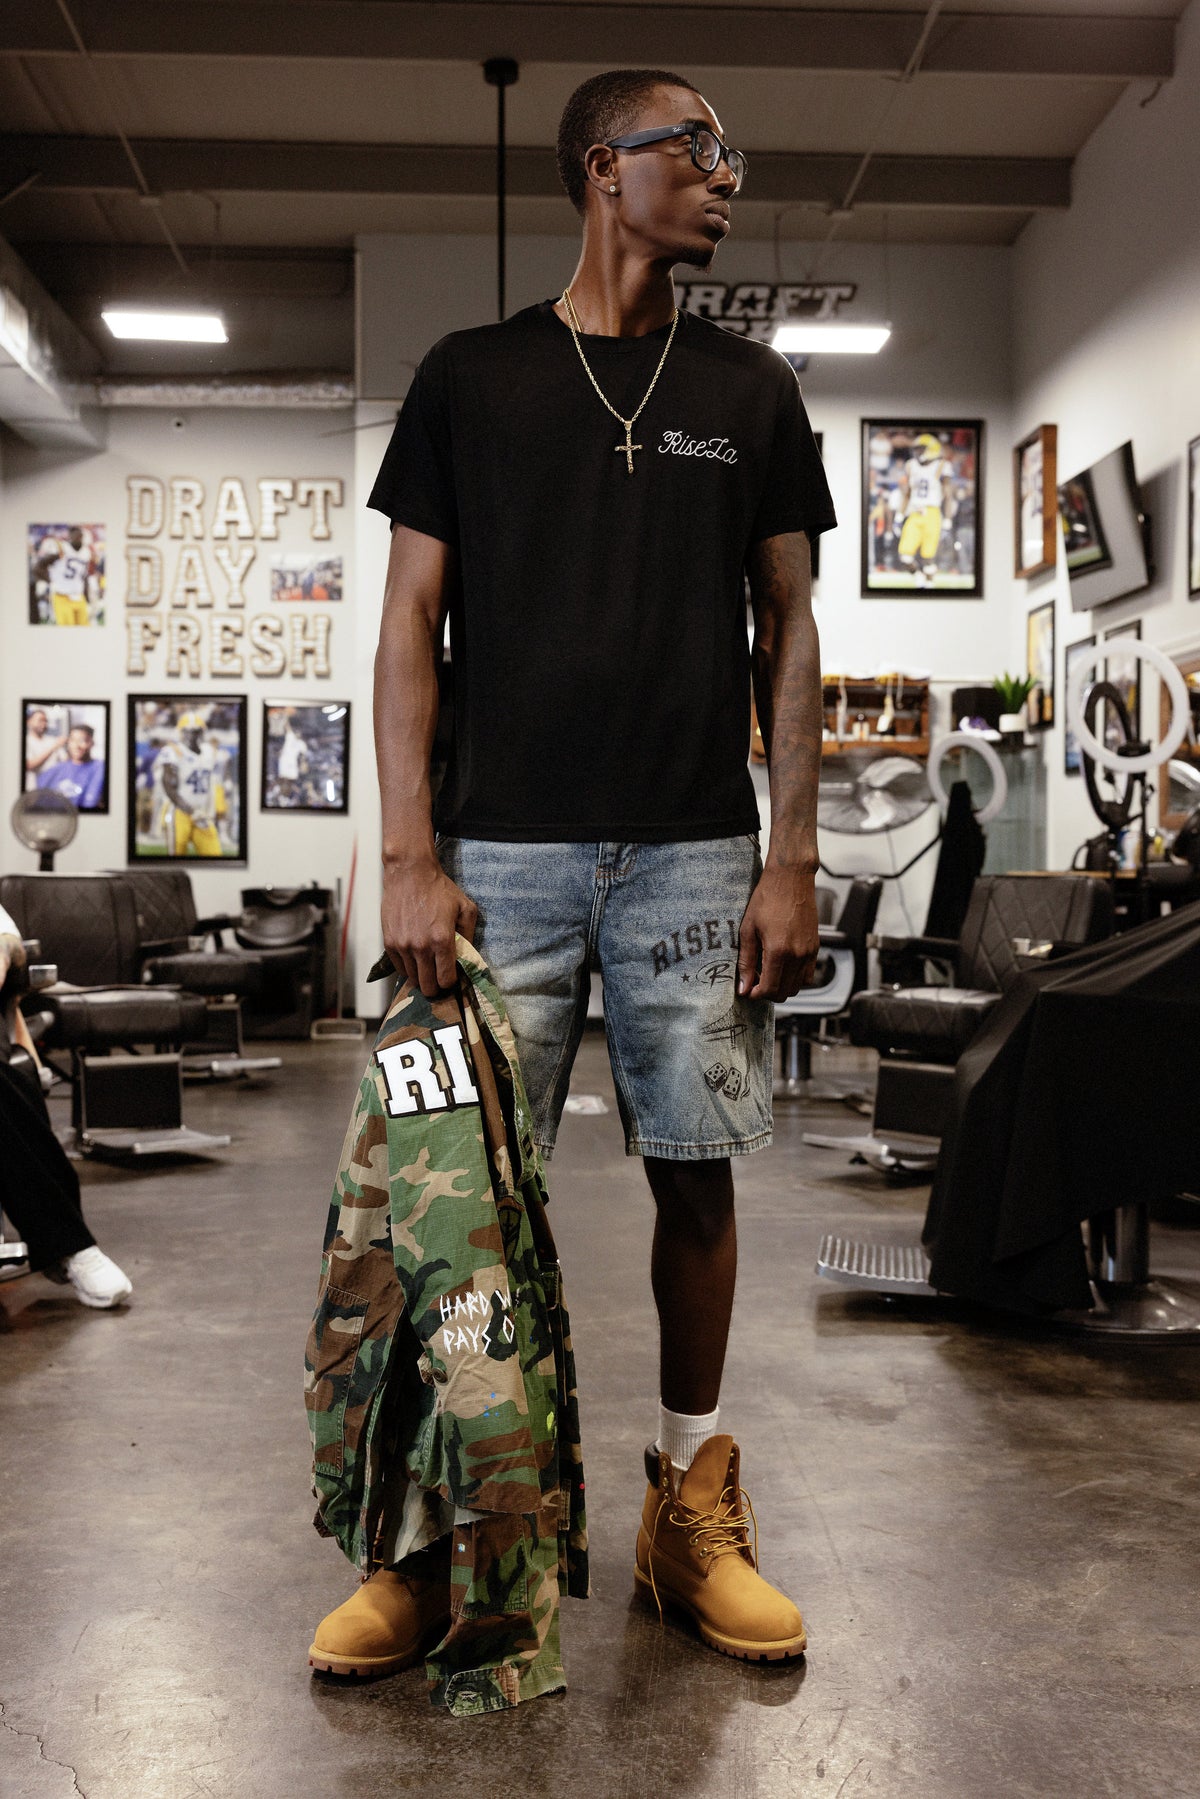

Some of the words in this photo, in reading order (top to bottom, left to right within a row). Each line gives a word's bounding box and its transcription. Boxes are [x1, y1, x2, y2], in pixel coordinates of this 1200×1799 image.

[126, 475, 344, 541] DRAFT
[125, 545, 257, 609] DAY
[126, 612, 332, 679] FRESH
[374, 1023, 481, 1118] RI
[440, 1290, 490, 1323] HARD
[443, 1320, 492, 1355] PAYS
